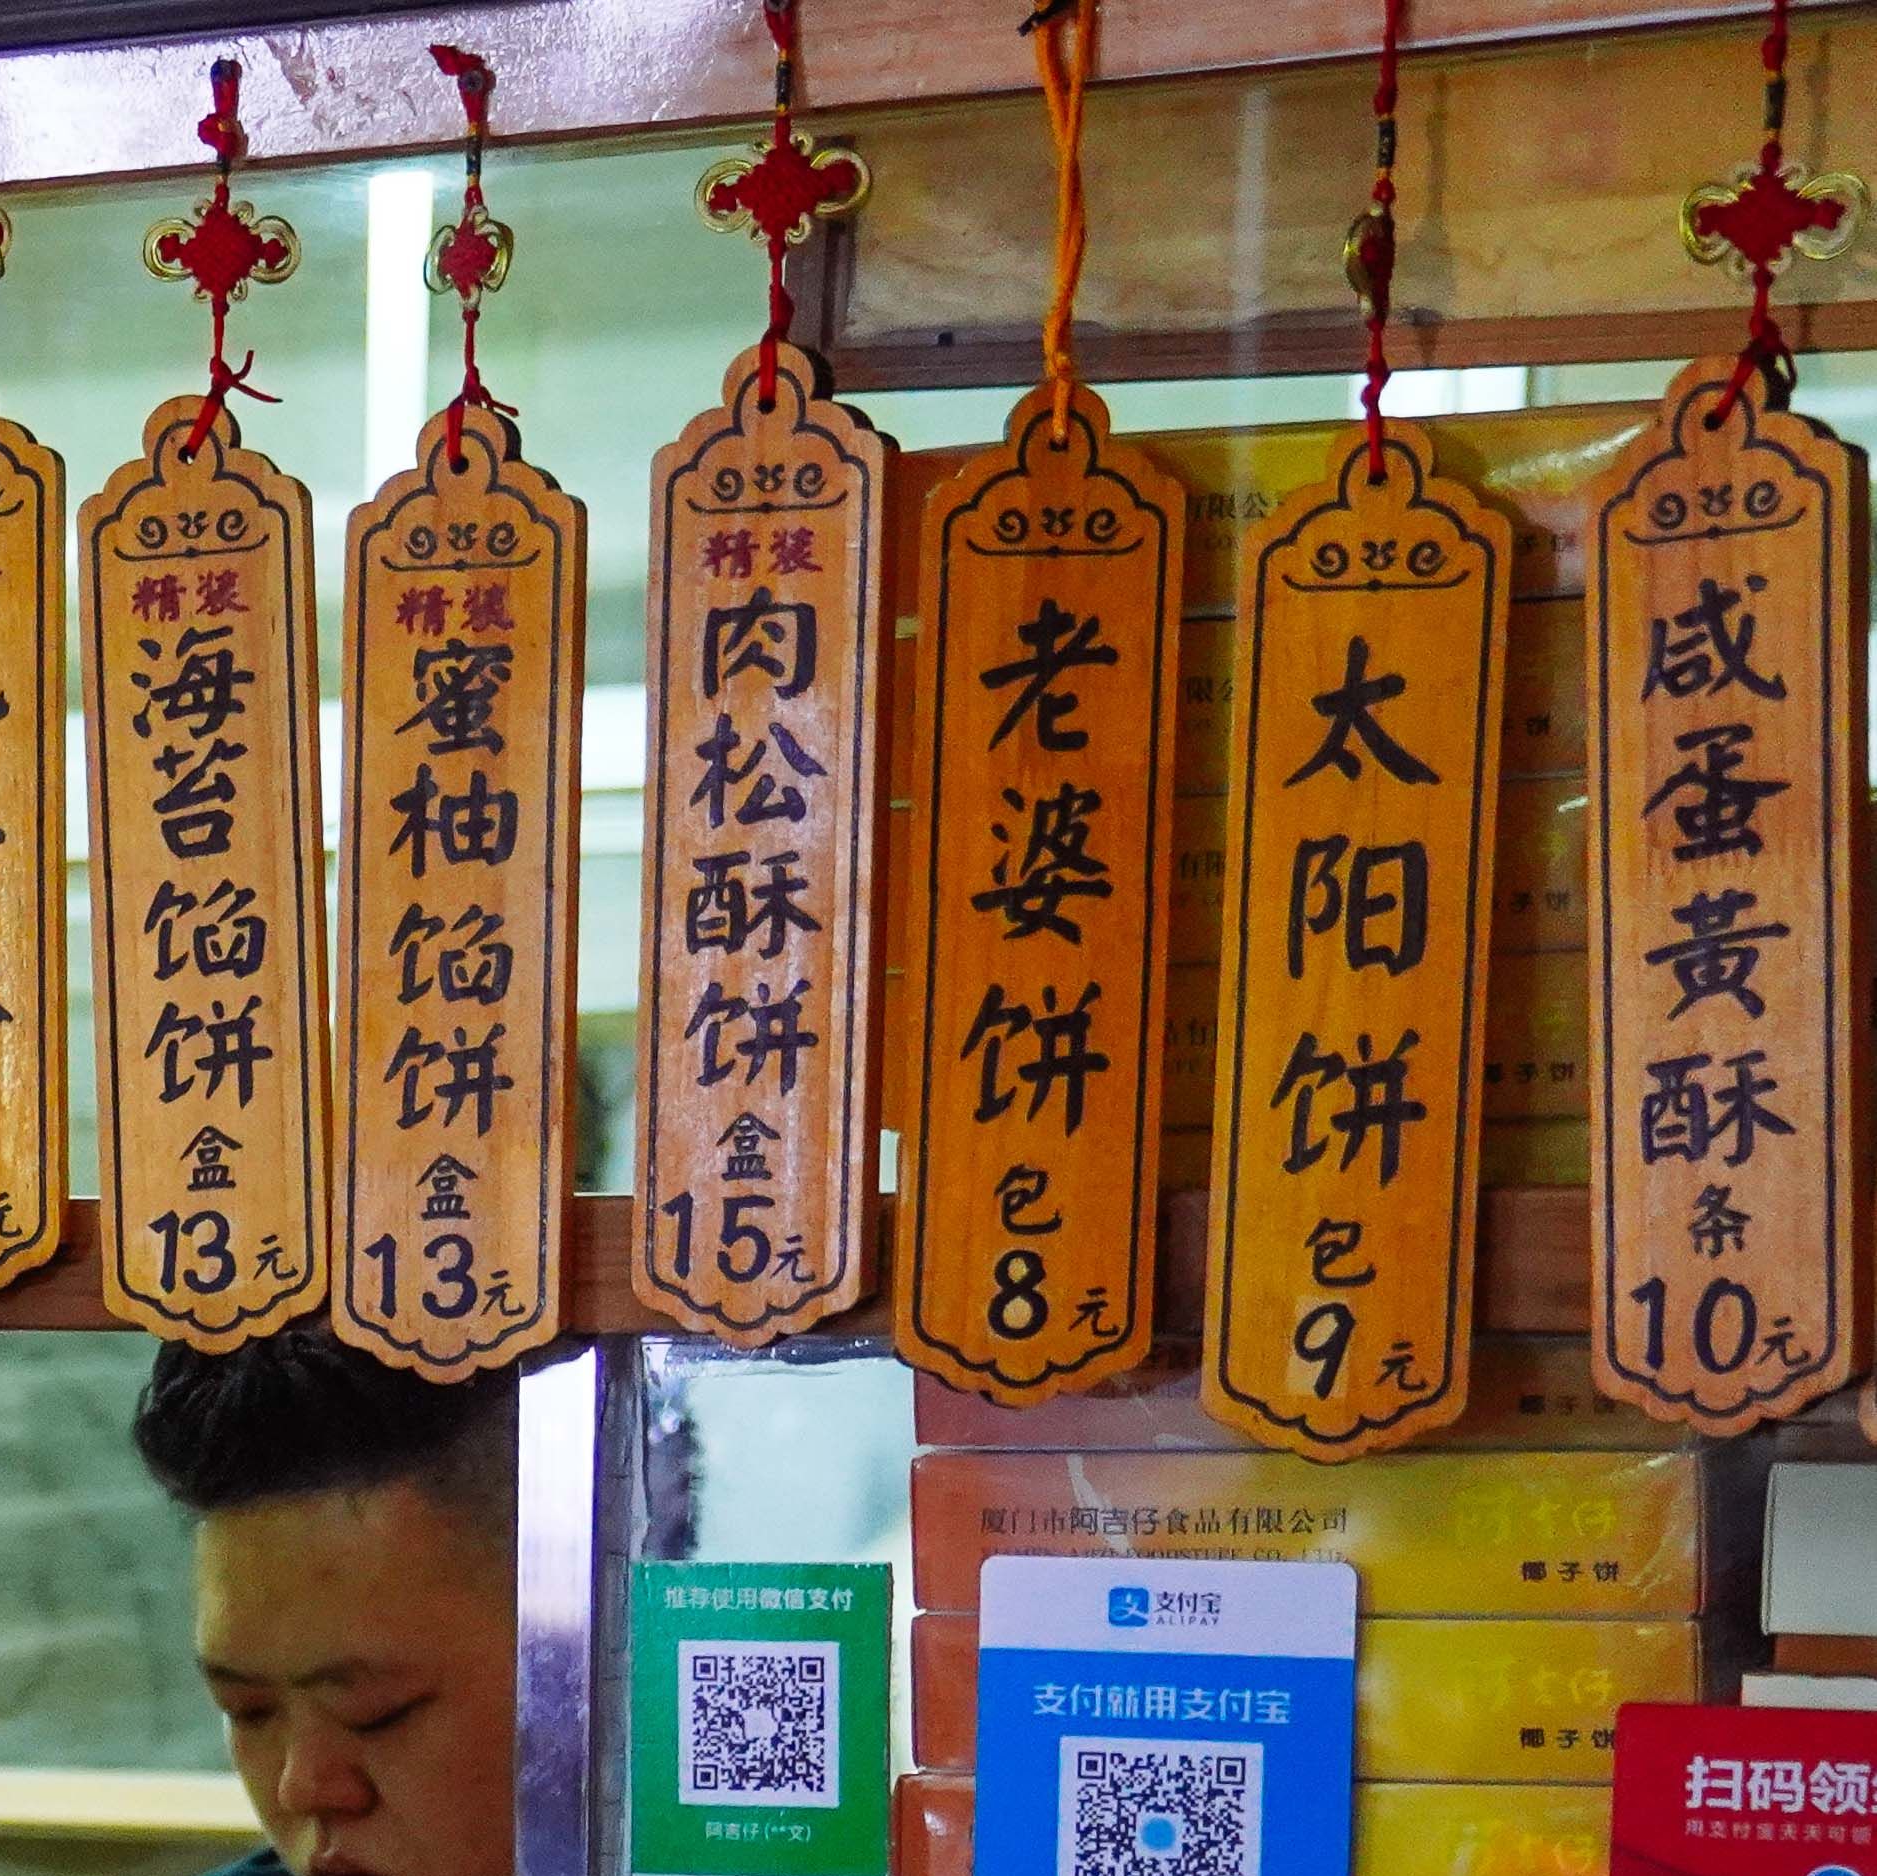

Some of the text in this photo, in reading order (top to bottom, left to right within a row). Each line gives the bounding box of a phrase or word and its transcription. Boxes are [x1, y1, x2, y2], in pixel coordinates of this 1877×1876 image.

[701, 527, 824, 578] 精装
[132, 571, 250, 621] 精装
[394, 585, 516, 635] 精装
[130, 625, 273, 1110] 海苔馅饼
[684, 598, 830, 1097] 肉松酥饼
[960, 598, 1118, 1139] 老婆饼
[384, 637, 519, 1139] 蜜柚馅饼
[1271, 635, 1440, 1187] 太阳饼
[179, 1125, 244, 1192] 盒
[715, 1111, 782, 1182] 盒
[415, 1154, 476, 1221] 盒
[994, 1165, 1061, 1238] 包
[1688, 1187, 1749, 1260] 条
[150, 1211, 300, 1294] 13元
[662, 1190, 817, 1288] 15元
[1307, 1217, 1375, 1290] 包
[365, 1233, 526, 1321] 13元
[988, 1251, 1119, 1342] 8元
[1294, 1303, 1425, 1399] 9元
[1628, 1276, 1810, 1377] 10元
[980, 1505, 1347, 1537] 厦门市阿吉仔食品有限公司
[663, 1586, 854, 1612] 推荐使用微信支付
[1156, 1590, 1223, 1615] 支付宝
[1156, 1614, 1220, 1627] ALIPAY
[1033, 1682, 1292, 1724] 支付就用支付宝
[1685, 1759, 1877, 1816] 扫码领
